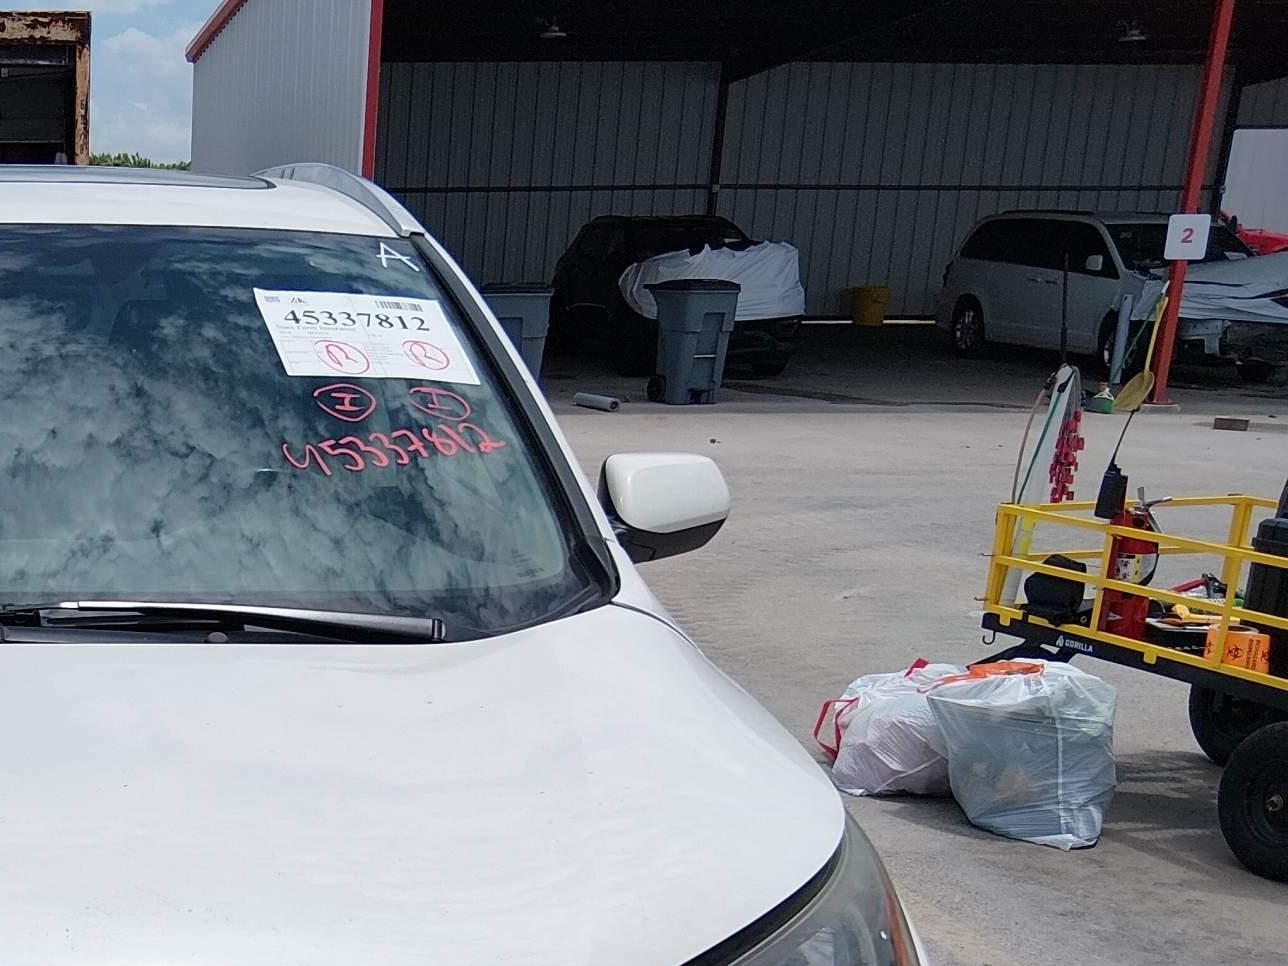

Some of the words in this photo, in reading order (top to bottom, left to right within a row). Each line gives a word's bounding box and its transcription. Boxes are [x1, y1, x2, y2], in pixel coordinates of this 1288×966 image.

[1181, 227, 1193, 244] 2
[376, 242, 420, 272] A
[283, 309, 430, 332] 45337812
[281, 422, 507, 476] 45337812
[1065, 639, 1093, 653] GORILLA
